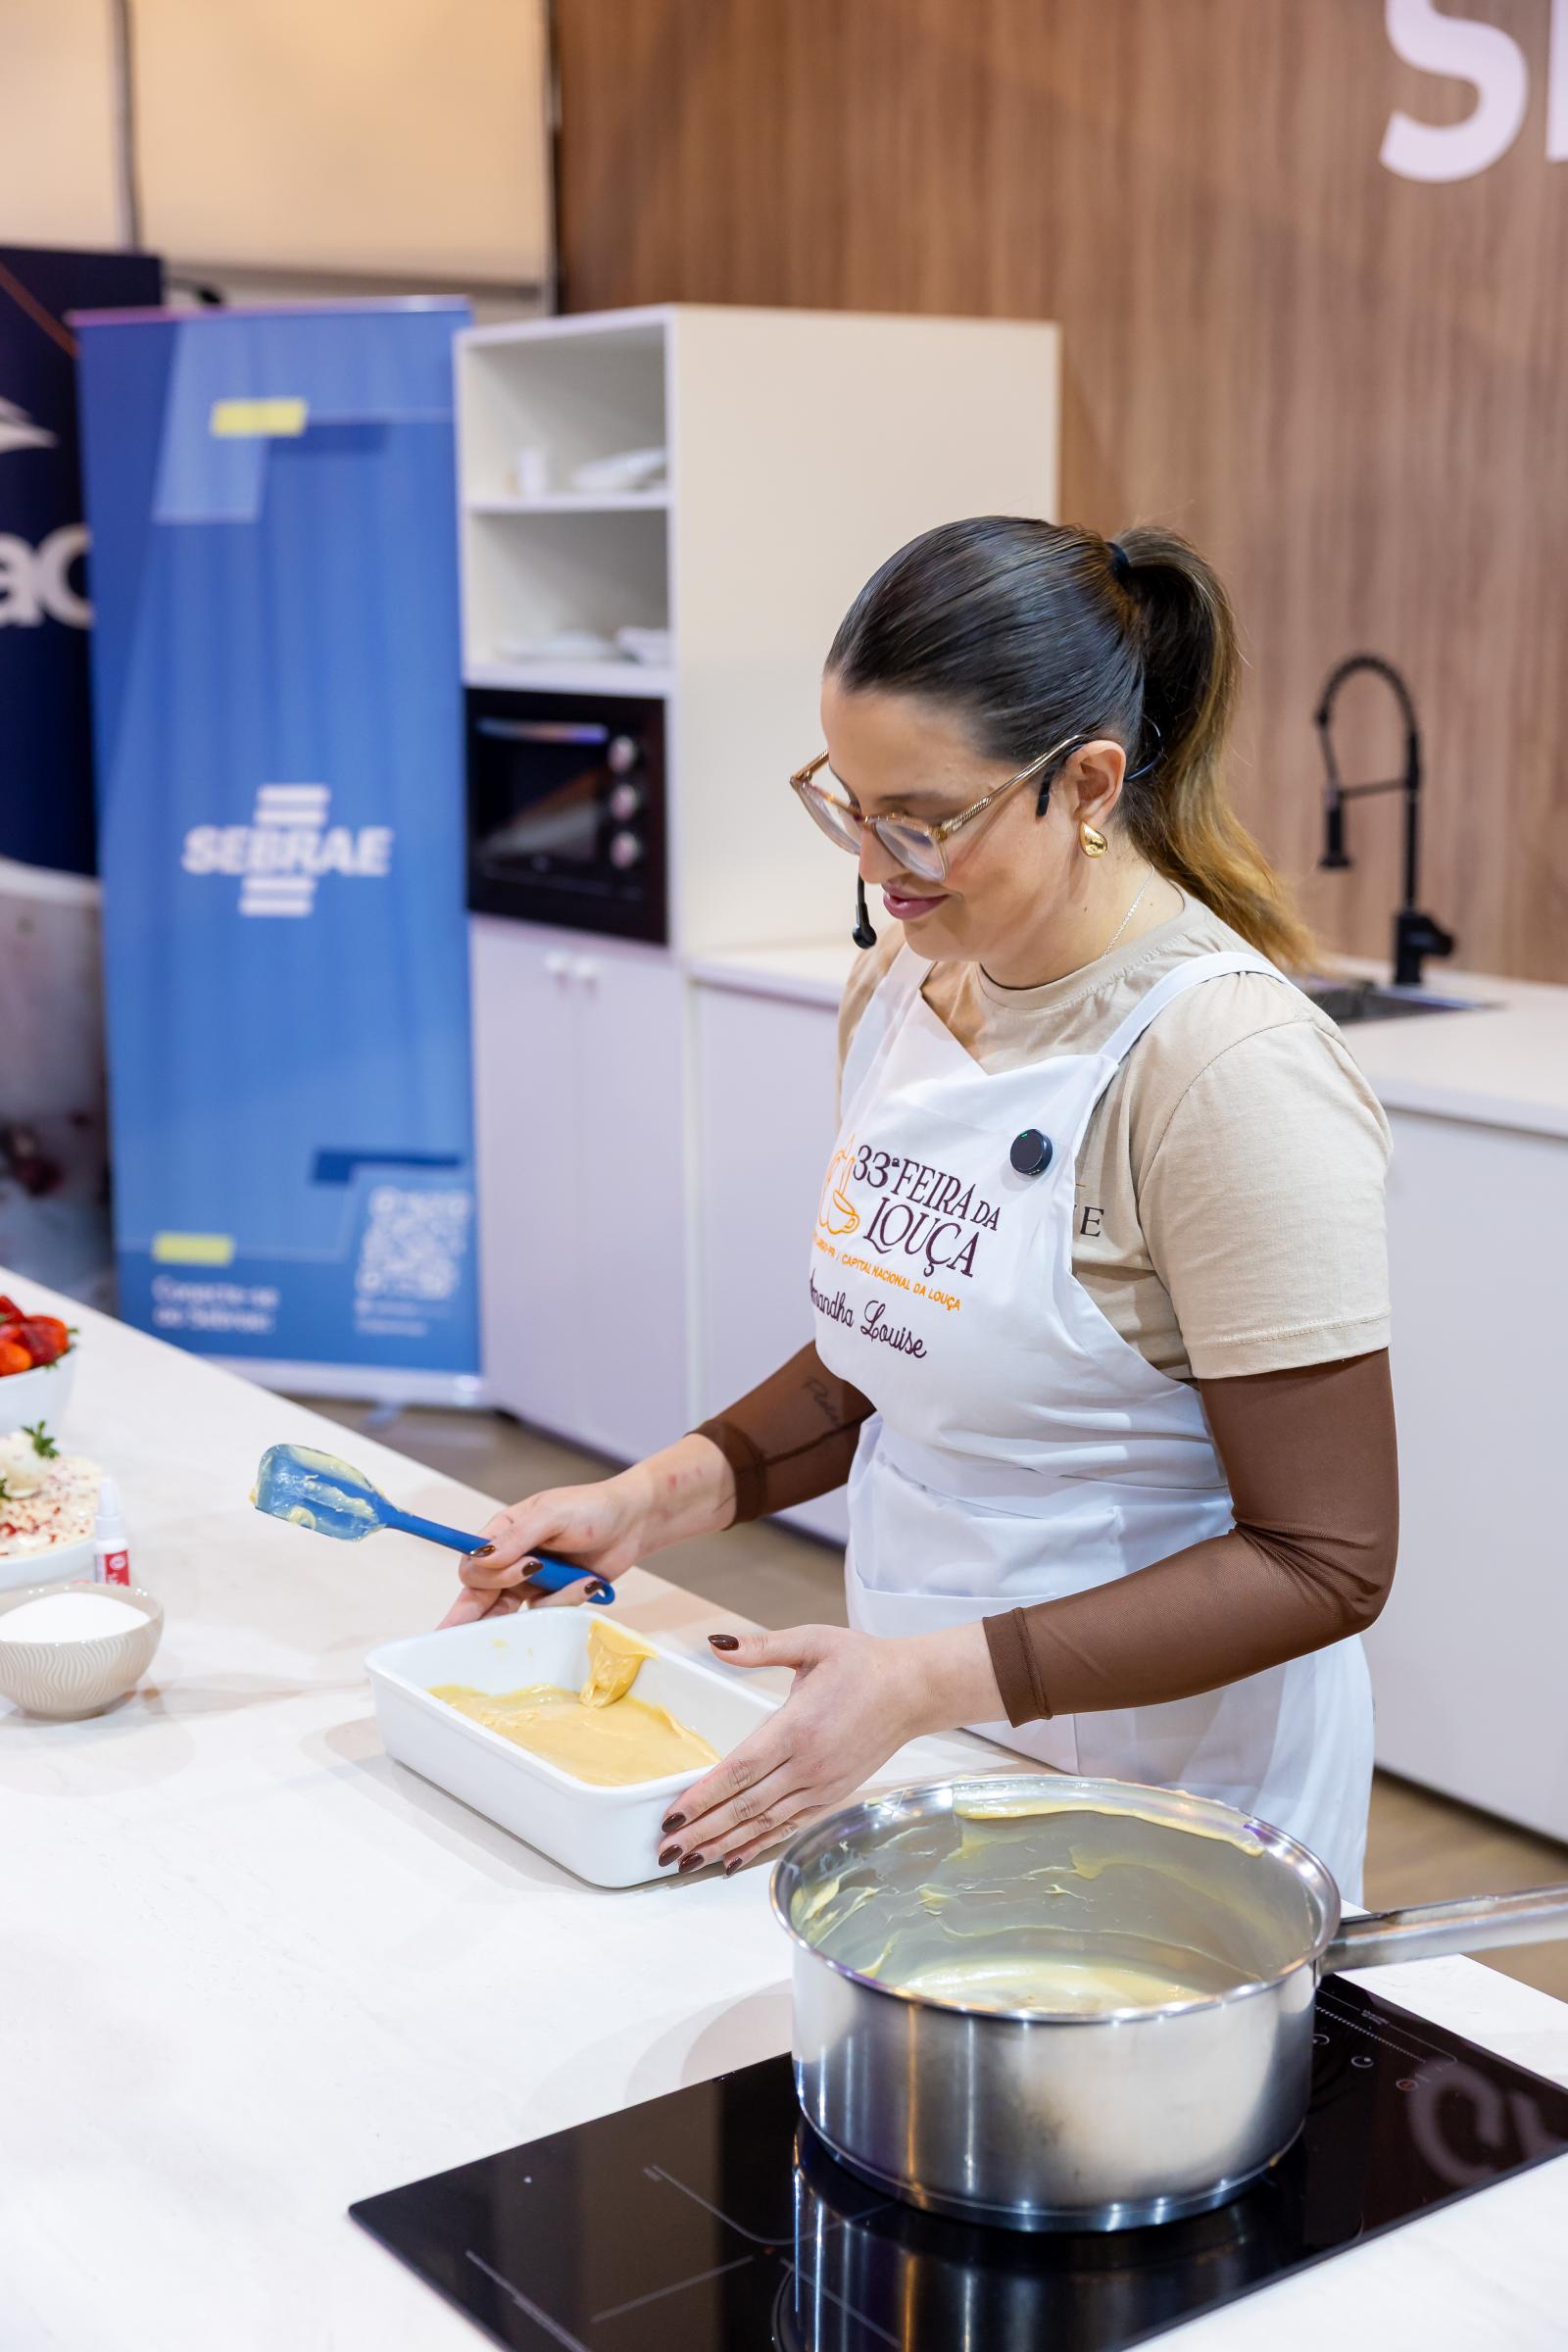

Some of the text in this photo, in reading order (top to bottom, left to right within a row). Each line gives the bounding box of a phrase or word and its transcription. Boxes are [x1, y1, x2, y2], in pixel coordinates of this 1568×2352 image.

[1379, 0, 1568, 183] S
[182, 824, 393, 876] SEBRAE
[853, 1144, 1001, 1232] 33ª FEIRA DA
[862, 1196, 980, 1278] LOUÇA
[842, 1253, 962, 1312] CAPITAL NACIONAL DA LOUÇA
[860, 1299, 928, 1359] Louise
